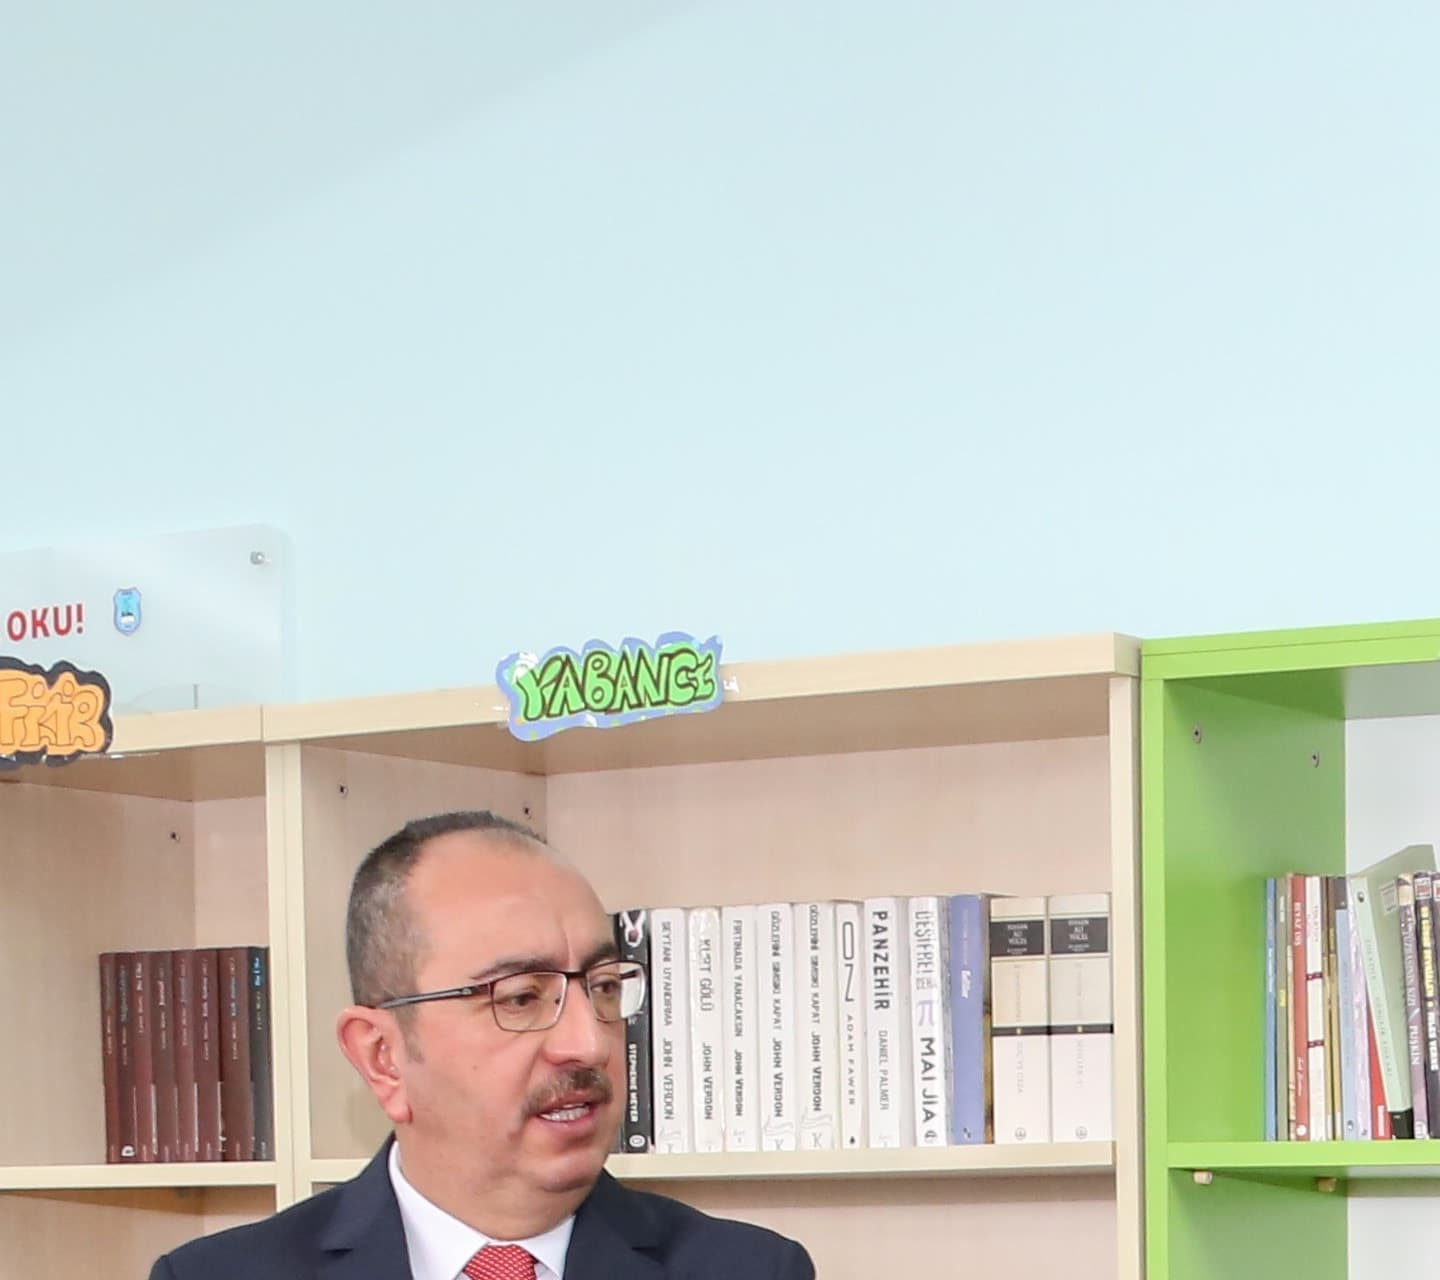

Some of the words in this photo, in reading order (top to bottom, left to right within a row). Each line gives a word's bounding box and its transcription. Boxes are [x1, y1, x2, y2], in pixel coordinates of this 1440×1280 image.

[6, 603, 84, 642] OKU!
[872, 911, 893, 1011] PANZEHİR
[663, 1074, 674, 1120] VERDON
